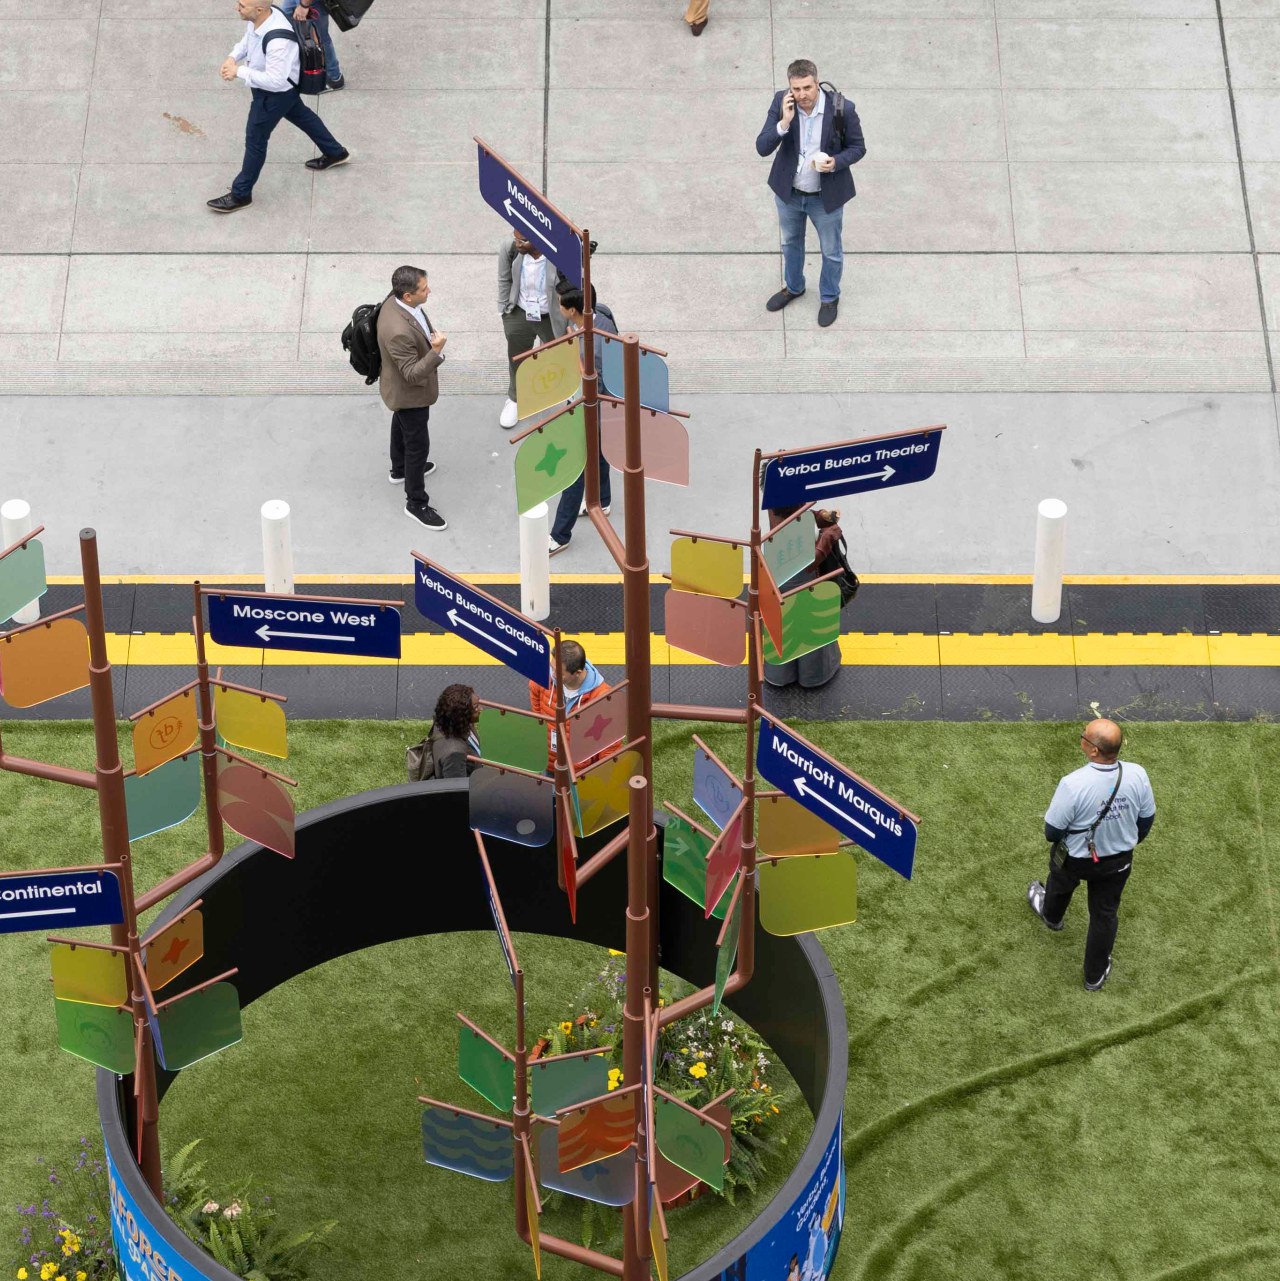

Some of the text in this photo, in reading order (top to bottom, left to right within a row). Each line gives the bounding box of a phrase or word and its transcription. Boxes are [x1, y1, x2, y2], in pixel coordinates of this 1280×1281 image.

[507, 179, 552, 231] Metreon
[778, 443, 930, 477] Yerba Buena Theater
[233, 604, 376, 627] Moscone West
[419, 571, 545, 654] Yerba Buena Gardens
[772, 735, 903, 837] Marriott Marquis
